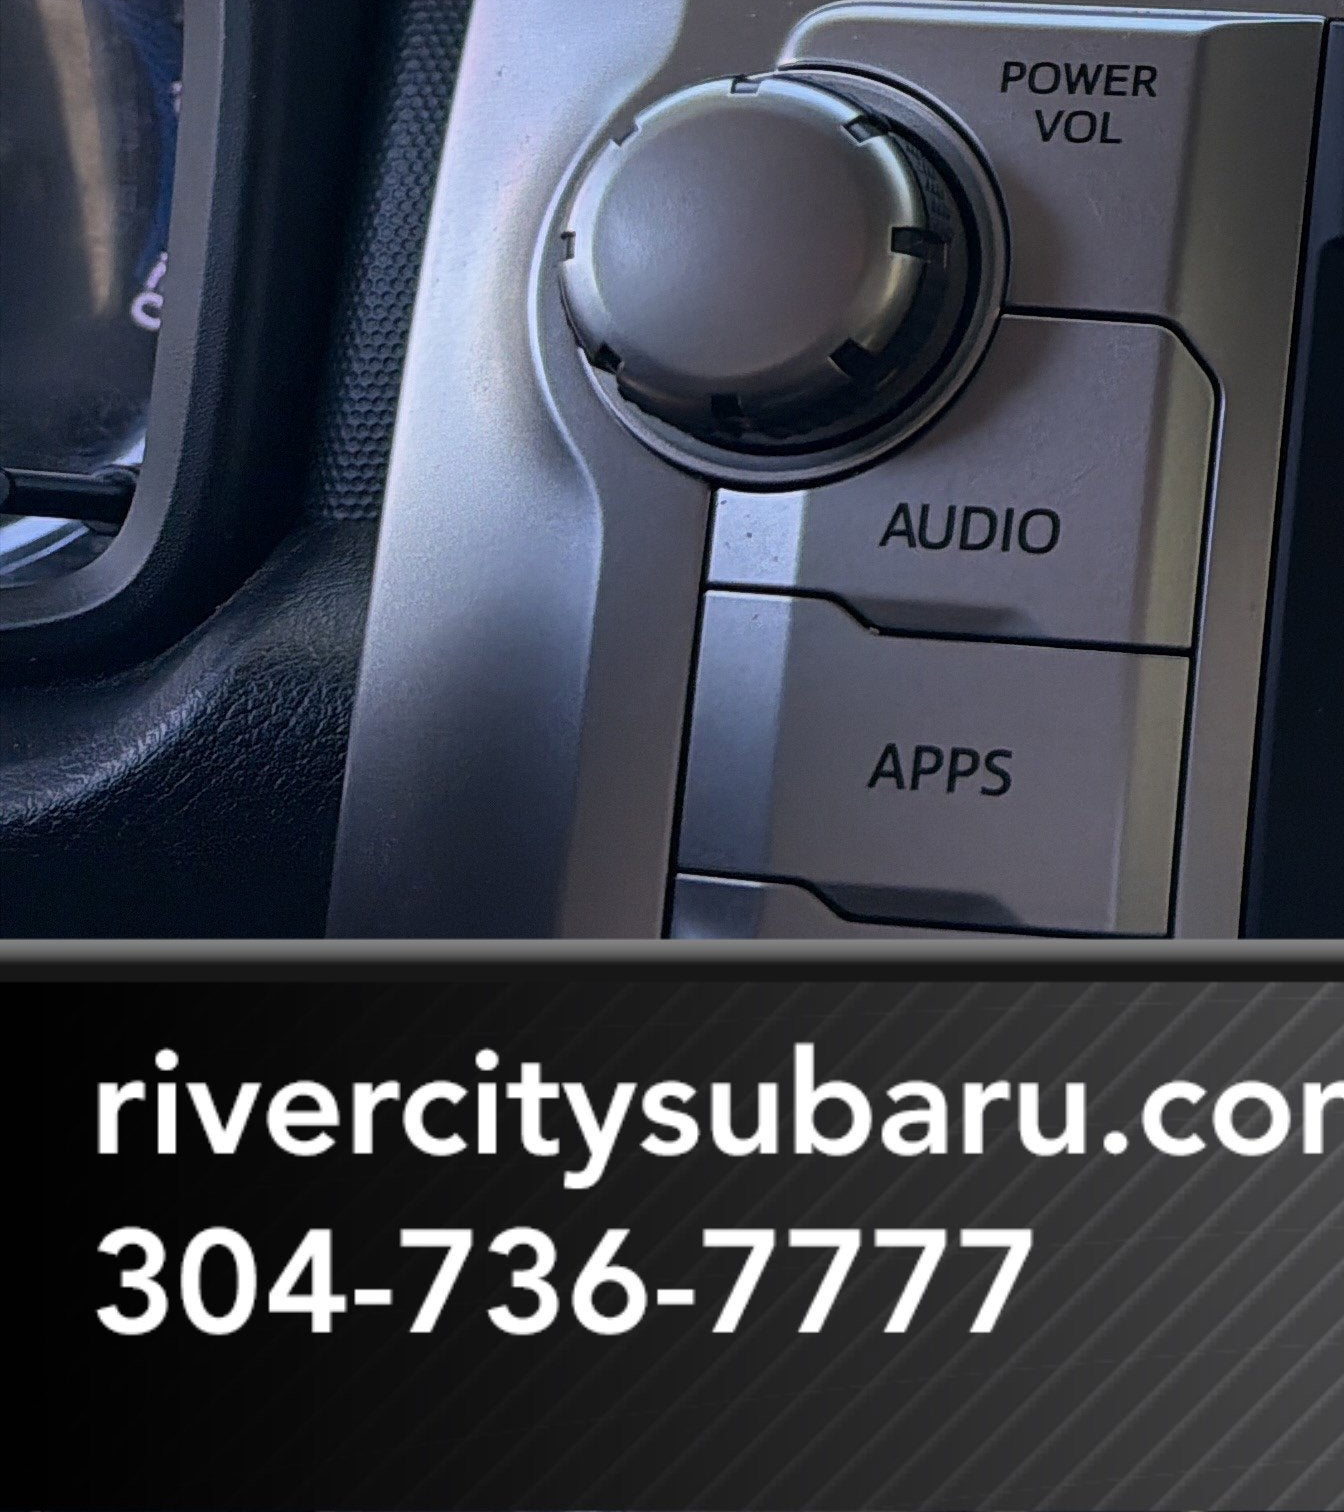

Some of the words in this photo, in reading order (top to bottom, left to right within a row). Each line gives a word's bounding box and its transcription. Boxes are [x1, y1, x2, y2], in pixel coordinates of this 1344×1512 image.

[1000, 60, 1158, 98] POWER
[1034, 109, 1123, 144] VOL
[878, 502, 1061, 555] AUDIO
[866, 742, 1013, 797] APPS
